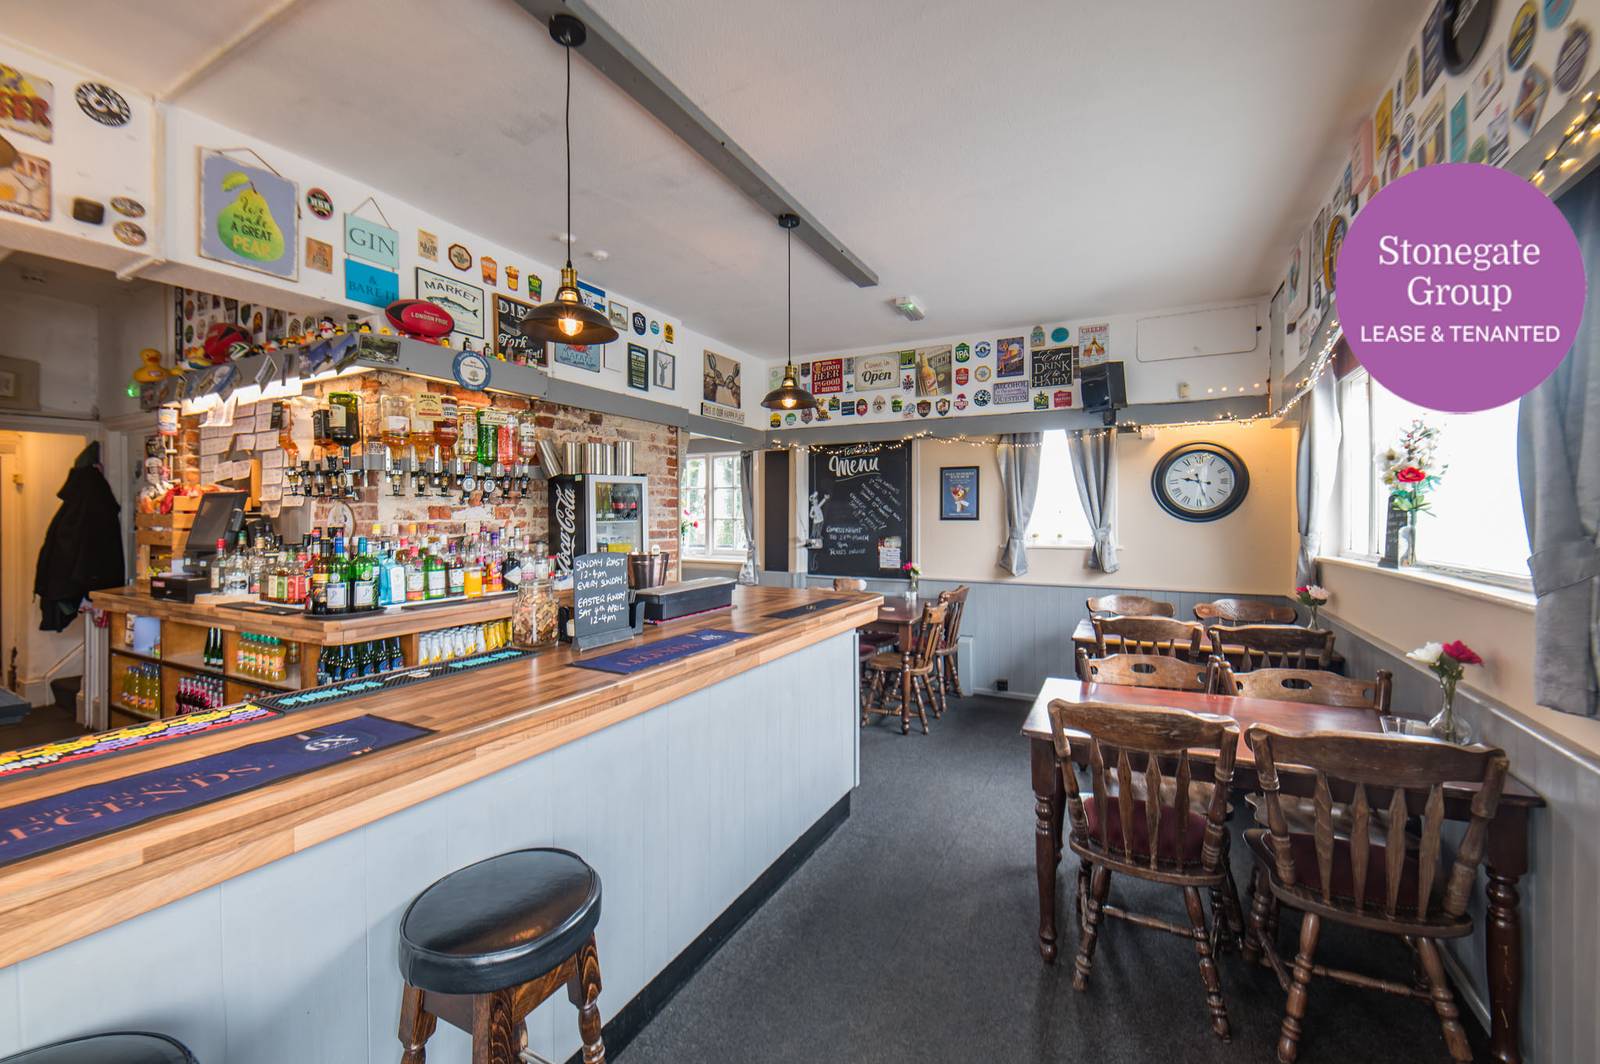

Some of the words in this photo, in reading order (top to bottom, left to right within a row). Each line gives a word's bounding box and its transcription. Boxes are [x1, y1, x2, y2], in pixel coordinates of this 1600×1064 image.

[231, 221, 239, 233] A
[241, 224, 272, 241] GREAT
[349, 227, 395, 256] GIN
[424, 280, 478, 303] MARKET
[956, 350, 969, 360] IPA
[1041, 350, 1063, 362] Eat
[821, 364, 840, 372] GOOD
[1035, 360, 1070, 375] DRINK
[815, 370, 840, 381] BEER
[861, 371, 892, 385] Open
[1034, 373, 1070, 387] HAPPY
[822, 379, 841, 387] GOOD
[829, 455, 880, 477] Menu
[555, 484, 576, 577] Coca-Cola
[576, 559, 603, 571] SUNDAY
[606, 557, 625, 567] ROAST
[577, 580, 598, 590] EVERY
[577, 594, 605, 608] EASTER
[578, 608, 592, 619] SAT
[608, 603, 625, 613] APRIL
[590, 614, 617, 625] 12-4pm
[0, 762, 276, 846] EGENDS.
